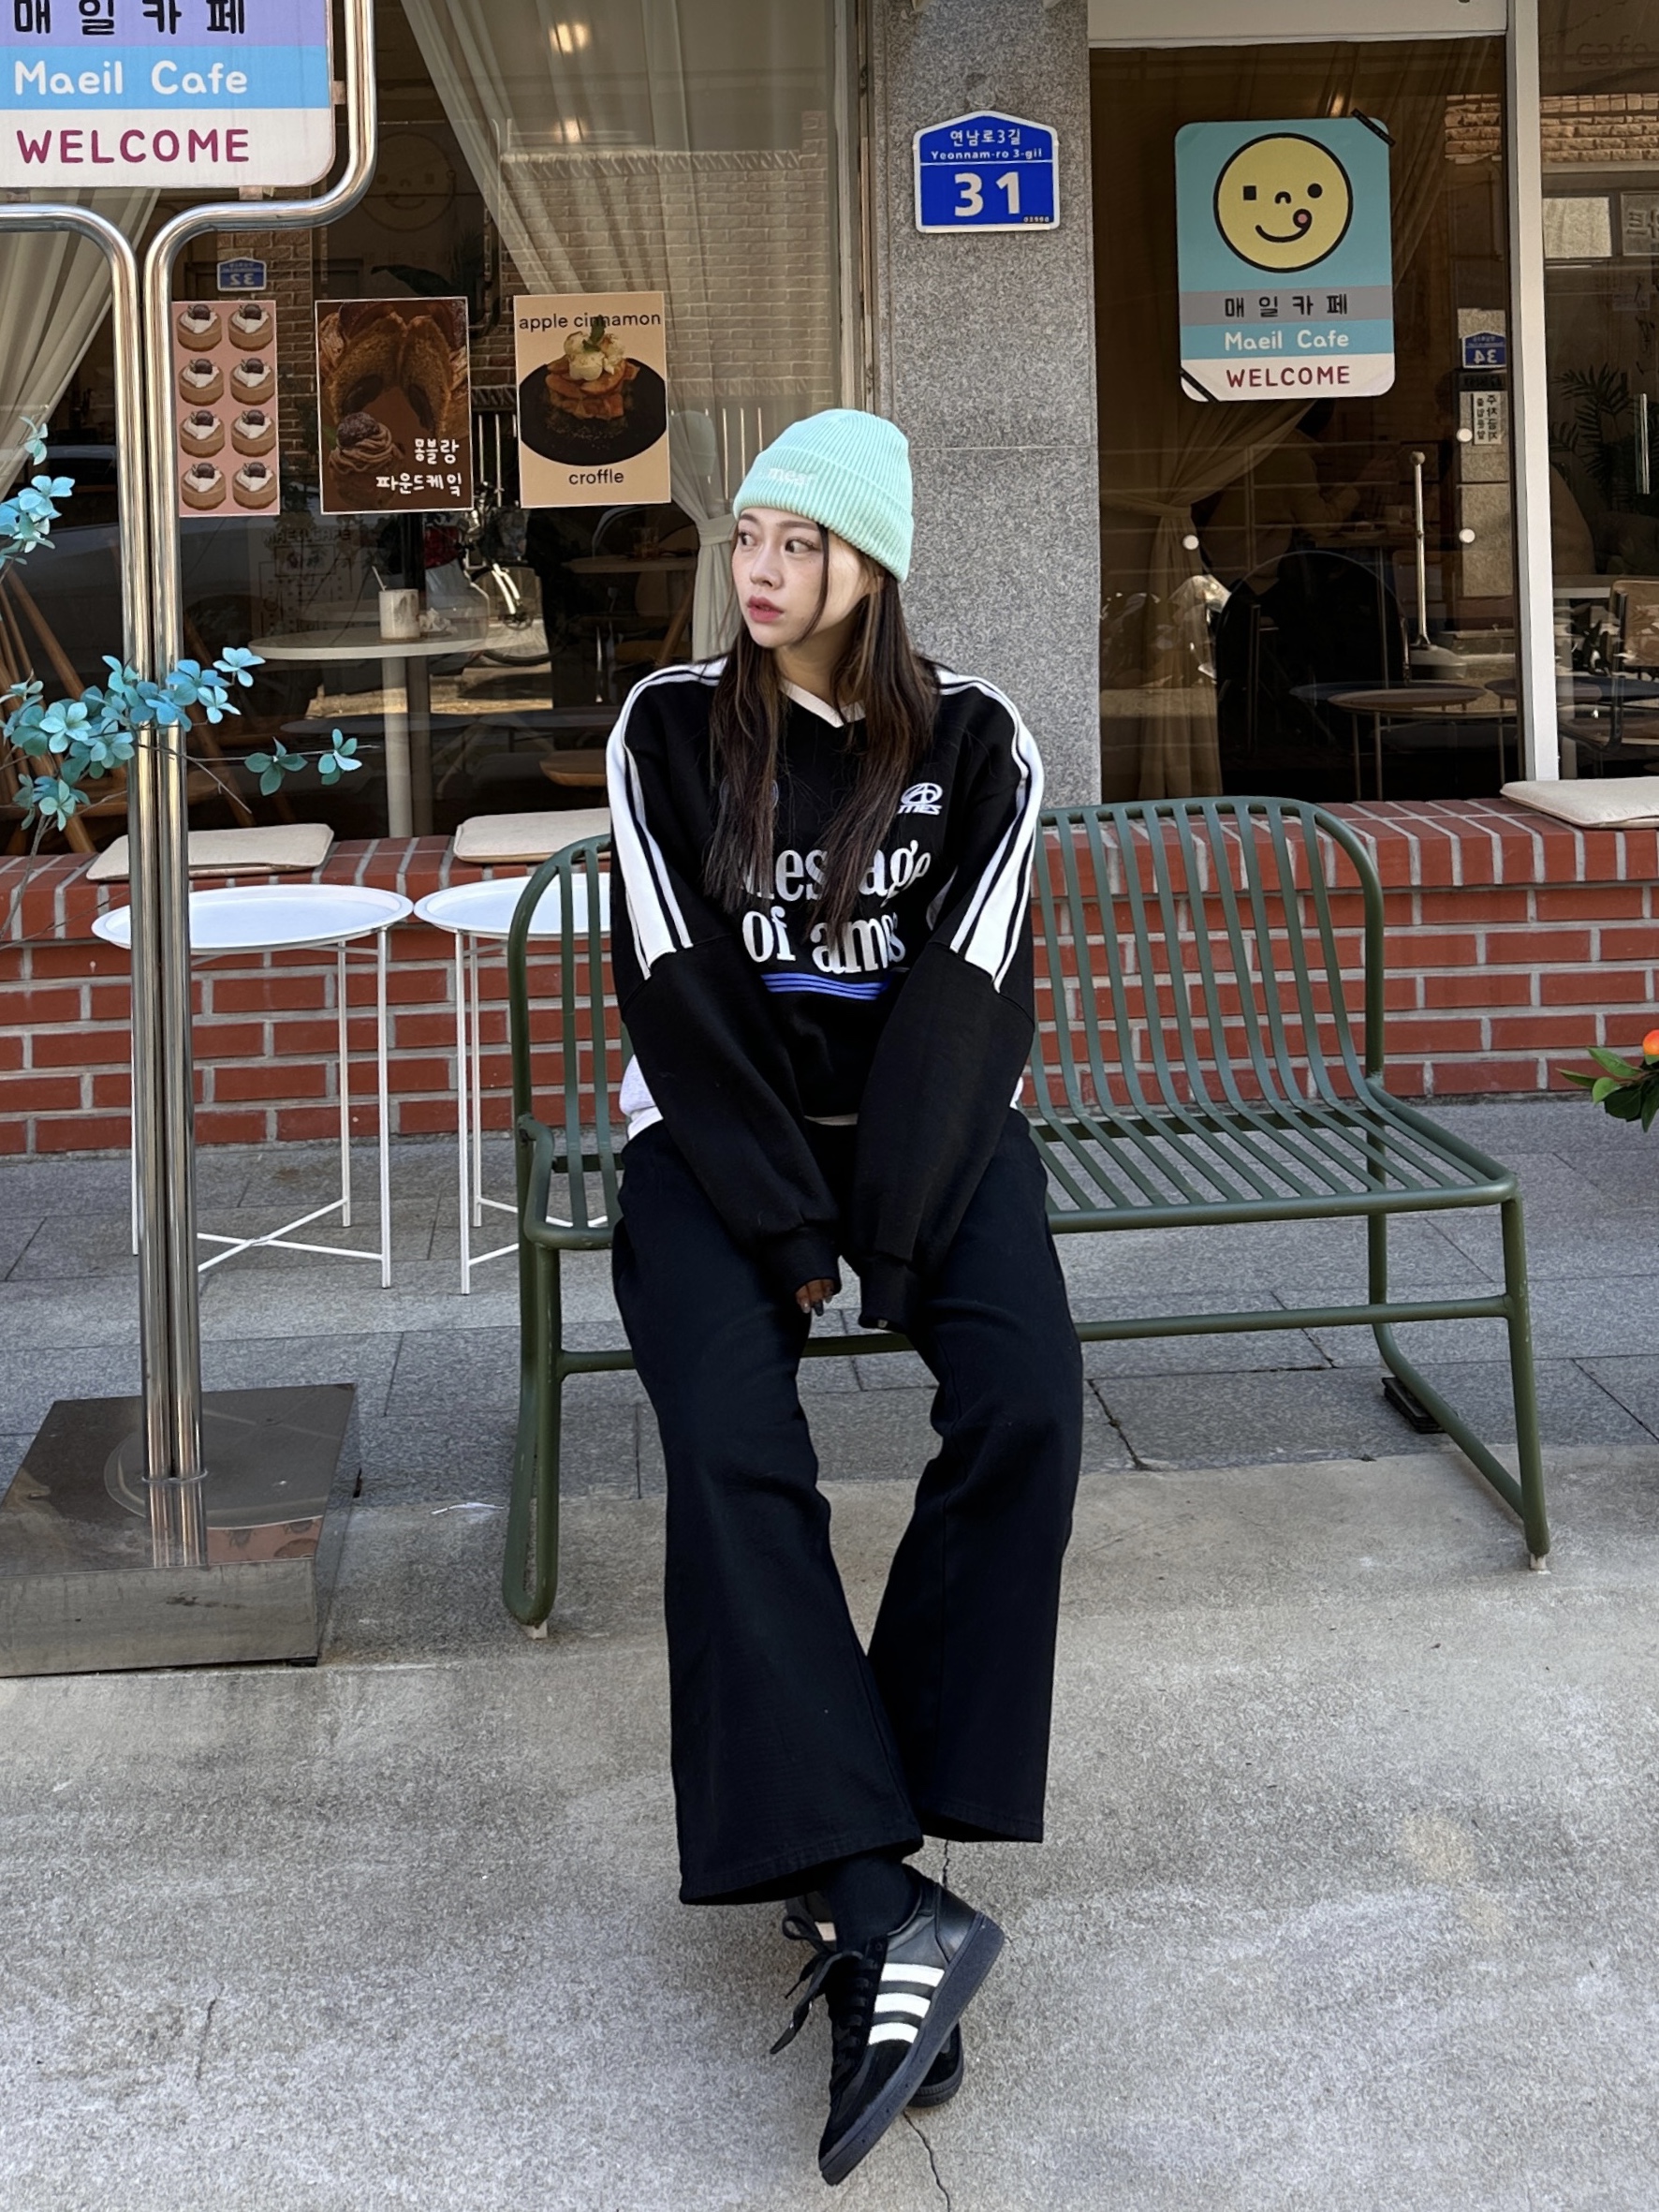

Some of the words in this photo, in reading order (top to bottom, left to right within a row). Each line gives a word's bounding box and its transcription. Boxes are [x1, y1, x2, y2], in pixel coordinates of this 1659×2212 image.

[14, 59, 124, 96] Maeil
[151, 59, 248, 96] Cafe
[16, 128, 250, 164] WELCOME
[949, 128, 1021, 148] 연남로3길
[931, 150, 1009, 161] Yeonnam-ro
[1013, 148, 1043, 160] 3-gil
[954, 170, 1020, 217] 31
[519, 313, 568, 332] apple
[1224, 330, 1283, 351] Maeil
[1297, 329, 1349, 349] Cafe
[1226, 365, 1350, 389] WELCOME
[414, 437, 461, 465] 몽블랑
[375, 472, 462, 497] 파운드케익
[568, 469, 624, 485] croffle
[742, 906, 796, 963] of
